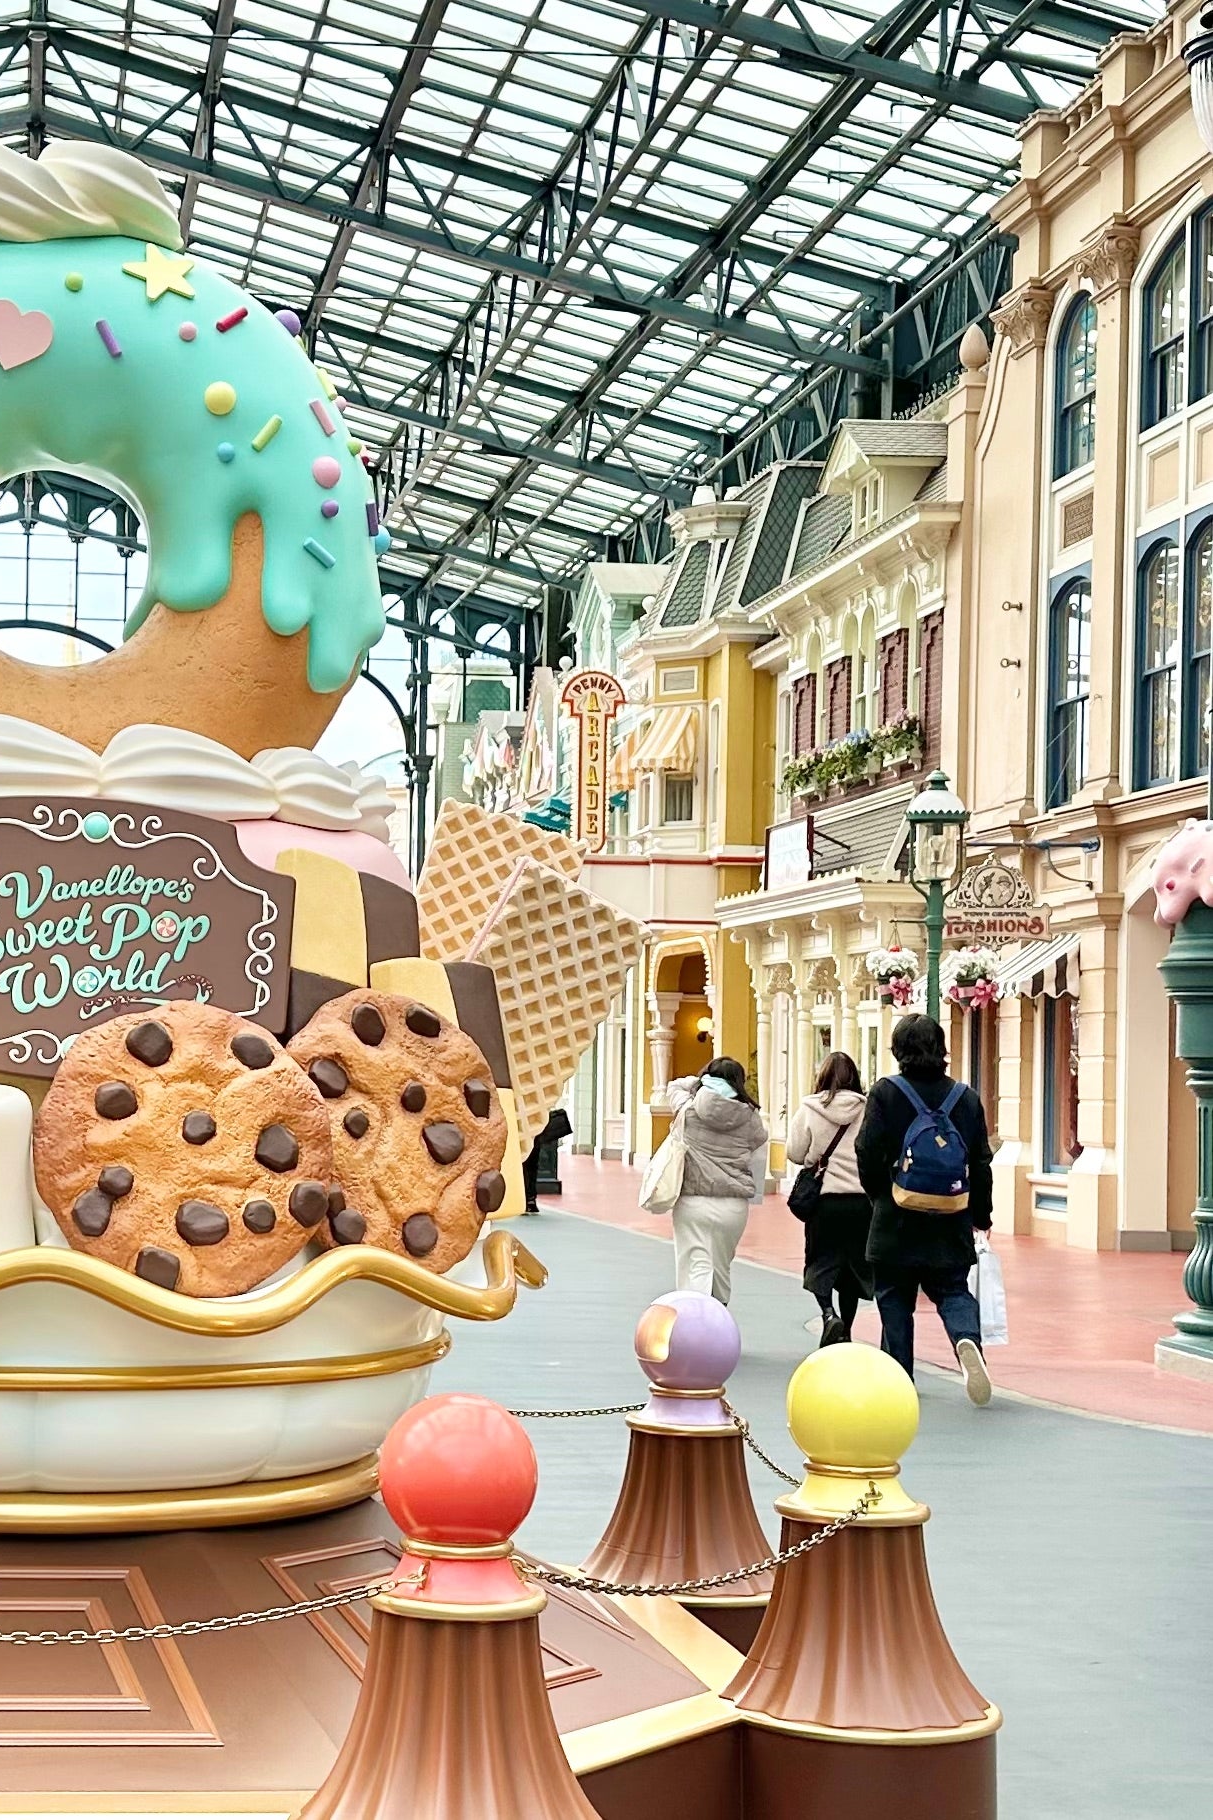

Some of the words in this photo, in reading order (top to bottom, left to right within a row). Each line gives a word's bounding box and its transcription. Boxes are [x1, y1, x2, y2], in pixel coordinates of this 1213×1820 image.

[573, 677, 616, 695] PENNY
[586, 691, 601, 835] ARCADE
[89, 902, 211, 963] Pop
[946, 916, 1044, 936] FASHIONS
